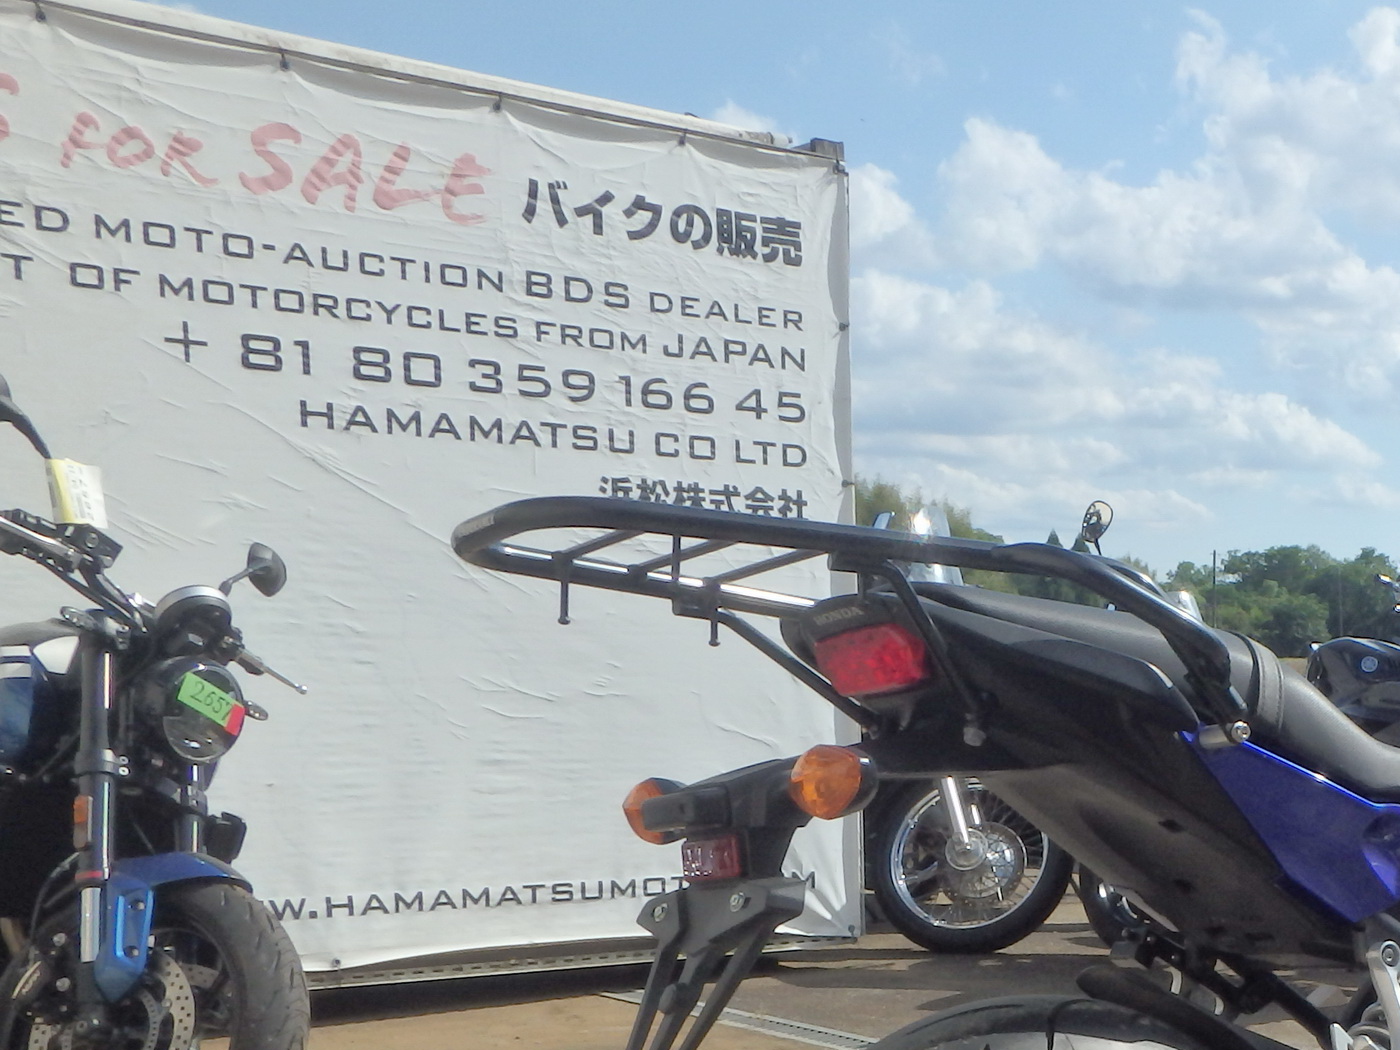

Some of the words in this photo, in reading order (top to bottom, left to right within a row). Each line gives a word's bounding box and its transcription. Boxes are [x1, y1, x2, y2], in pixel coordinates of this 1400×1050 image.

[60, 110, 219, 188] FOR
[238, 122, 491, 225] SALE
[521, 178, 803, 267] バイクの販売
[69, 261, 141, 293] OF
[158, 273, 519, 340] MOTORCYCLES
[535, 321, 647, 354] FROM
[662, 334, 806, 373] JAPAN
[94, 213, 504, 294] MOTO-AUCTION
[525, 270, 630, 309] BDS
[649, 292, 804, 332] DEALER
[164, 320, 208, 363] +
[240, 333, 312, 376] 81
[352, 345, 442, 388] 80
[467, 358, 597, 402] 359
[618, 374, 715, 415] 166
[734, 388, 807, 423] 45
[299, 399, 636, 455] HAMAMATSU
[655, 432, 717, 461] CO
[735, 438, 808, 468] LTD
[813, 606, 865, 627] HONDA
[189, 680, 231, 721] 2657
